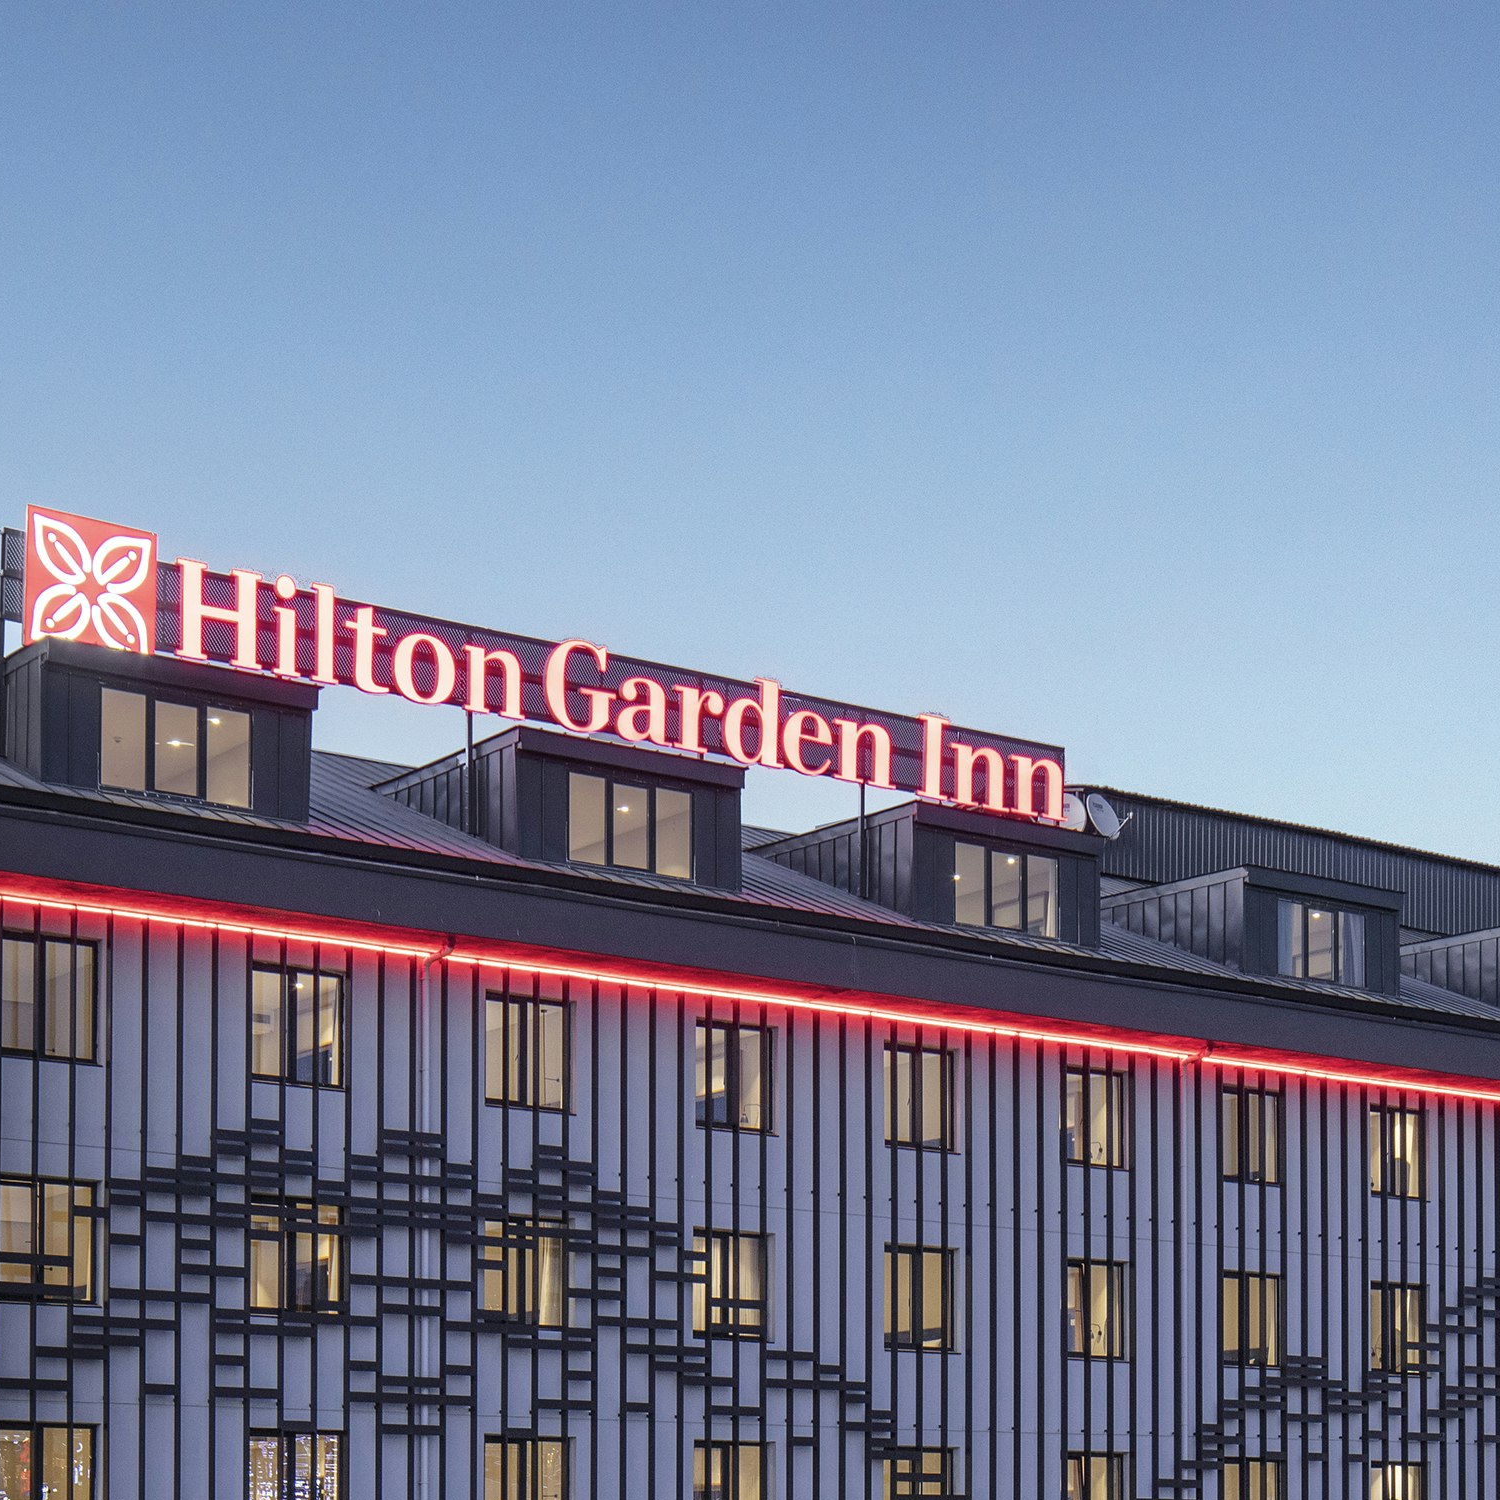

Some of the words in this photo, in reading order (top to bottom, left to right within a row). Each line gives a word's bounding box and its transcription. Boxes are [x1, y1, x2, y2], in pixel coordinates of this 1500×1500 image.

[174, 557, 526, 720] Hilton
[542, 638, 897, 790] Garden
[915, 712, 1068, 822] Inn
